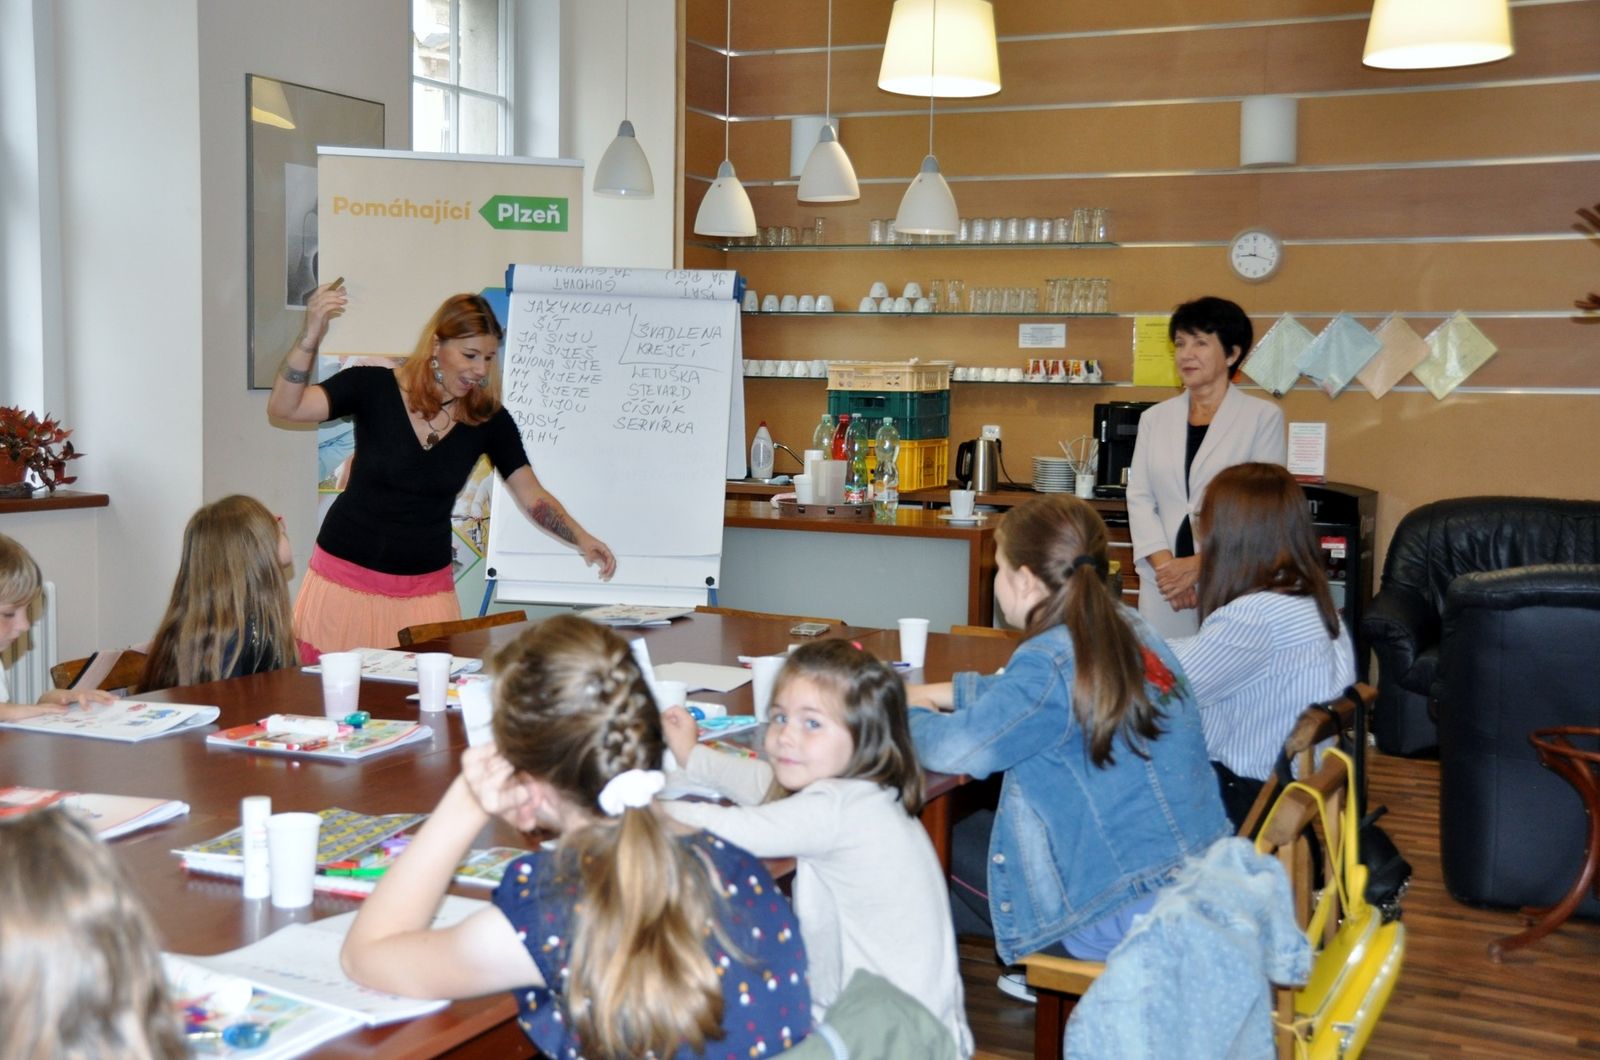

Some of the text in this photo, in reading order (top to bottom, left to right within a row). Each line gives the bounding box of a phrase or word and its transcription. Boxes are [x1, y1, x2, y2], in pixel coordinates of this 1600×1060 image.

[333, 196, 561, 225] Pomáhající Plzeň
[632, 364, 701, 384] LETUŠKA
[627, 382, 692, 401] STEVARD
